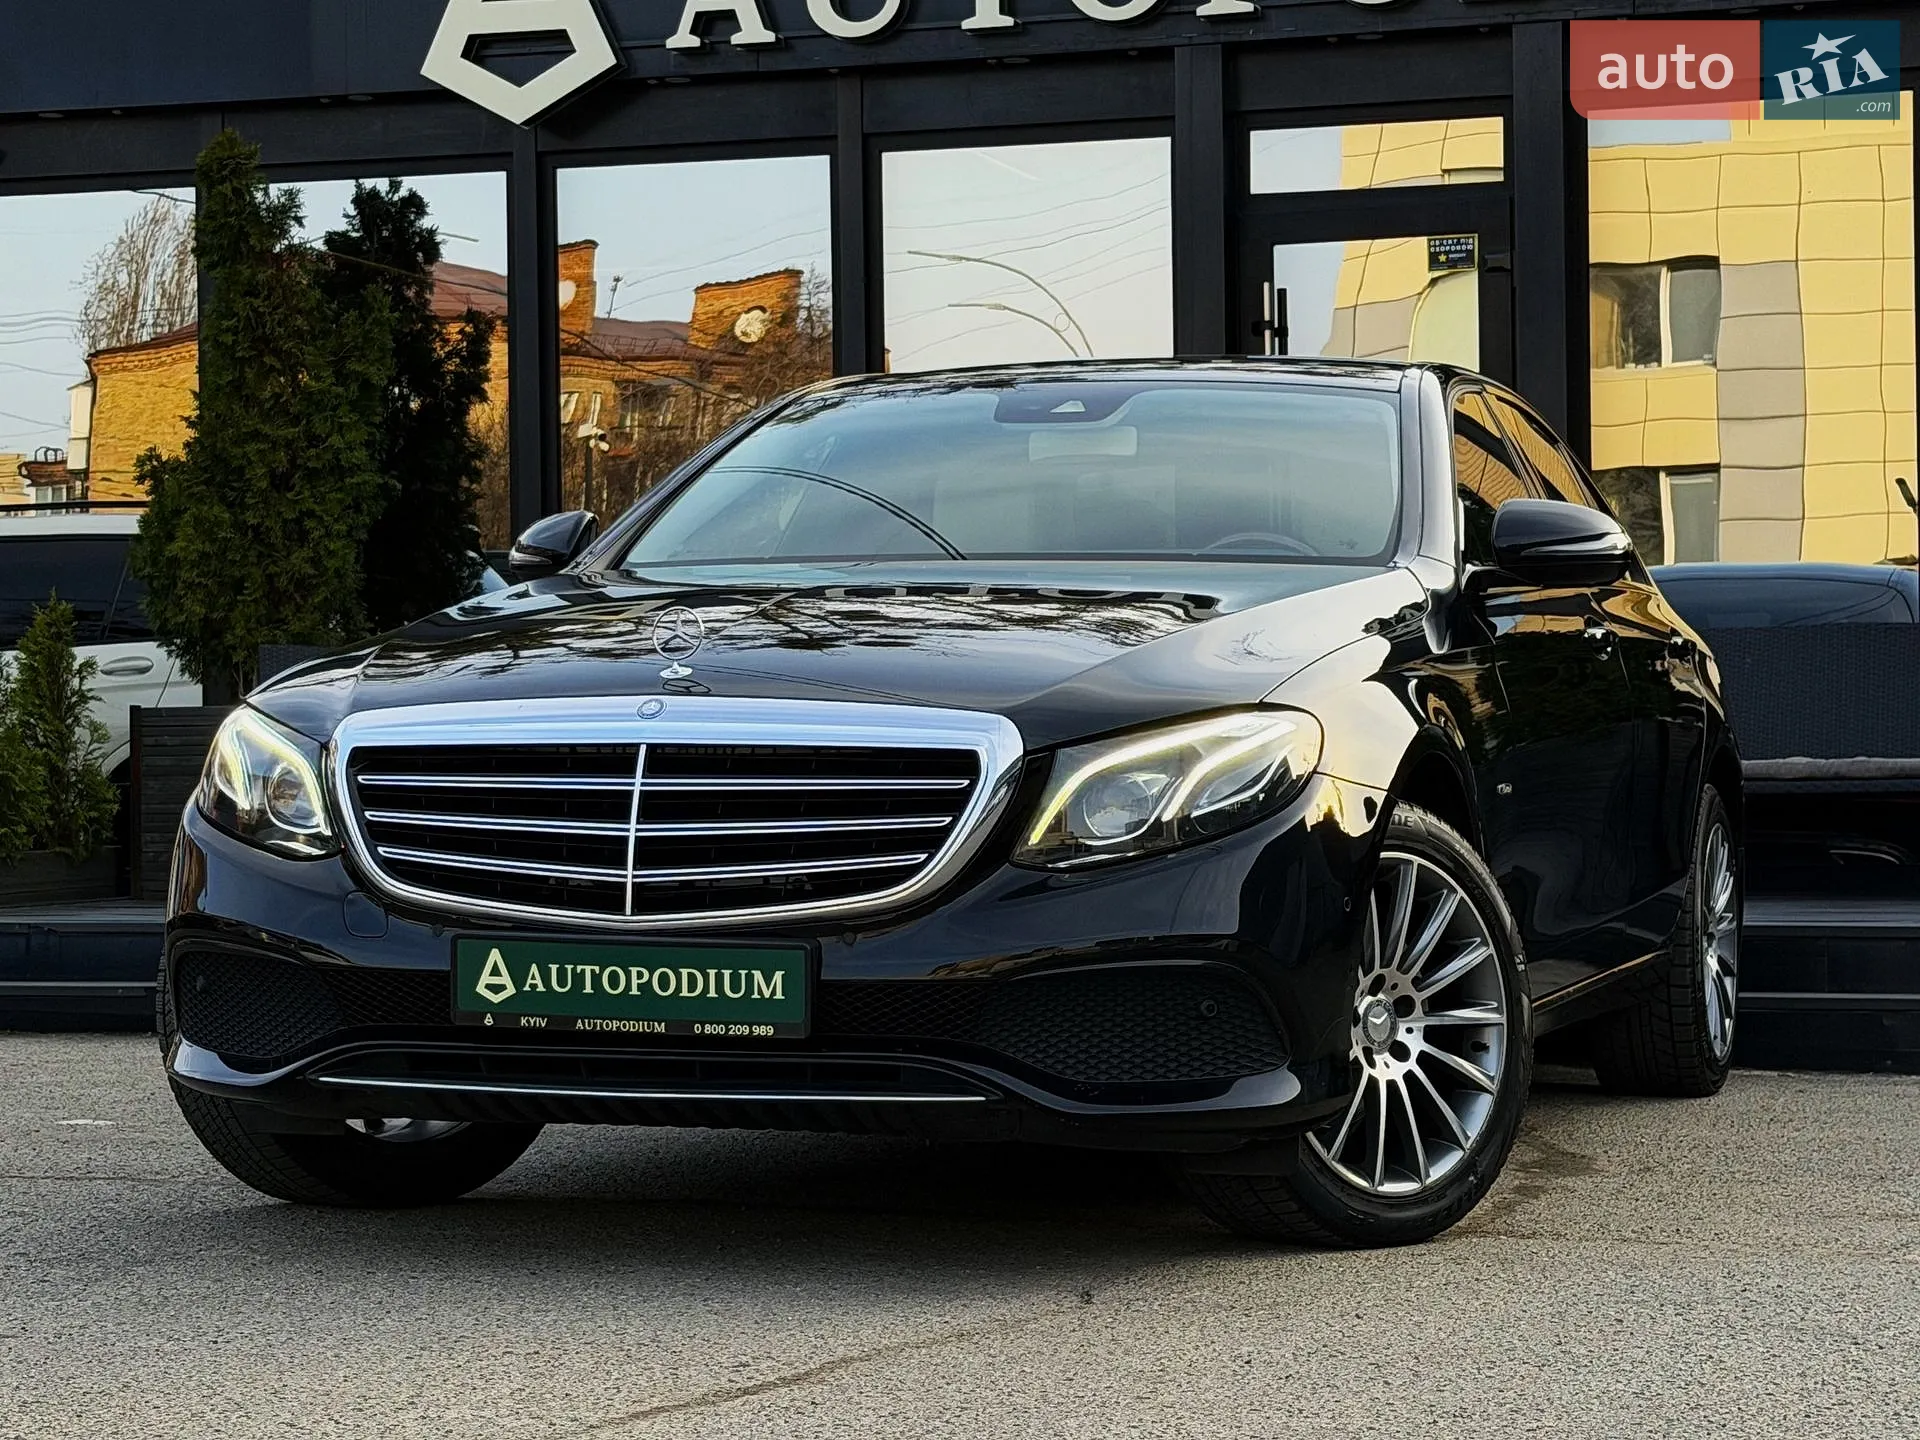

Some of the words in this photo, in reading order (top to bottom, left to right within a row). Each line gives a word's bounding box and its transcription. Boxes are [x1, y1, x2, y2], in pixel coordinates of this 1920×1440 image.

[522, 963, 786, 1000] AUTOPODIUM
[520, 1016, 548, 1029] KYIV
[575, 1018, 667, 1033] AUTOPODIUM
[693, 1023, 702, 1034] 0
[703, 1023, 726, 1035] 800
[727, 1024, 750, 1036] 209
[751, 1025, 774, 1036] 989
